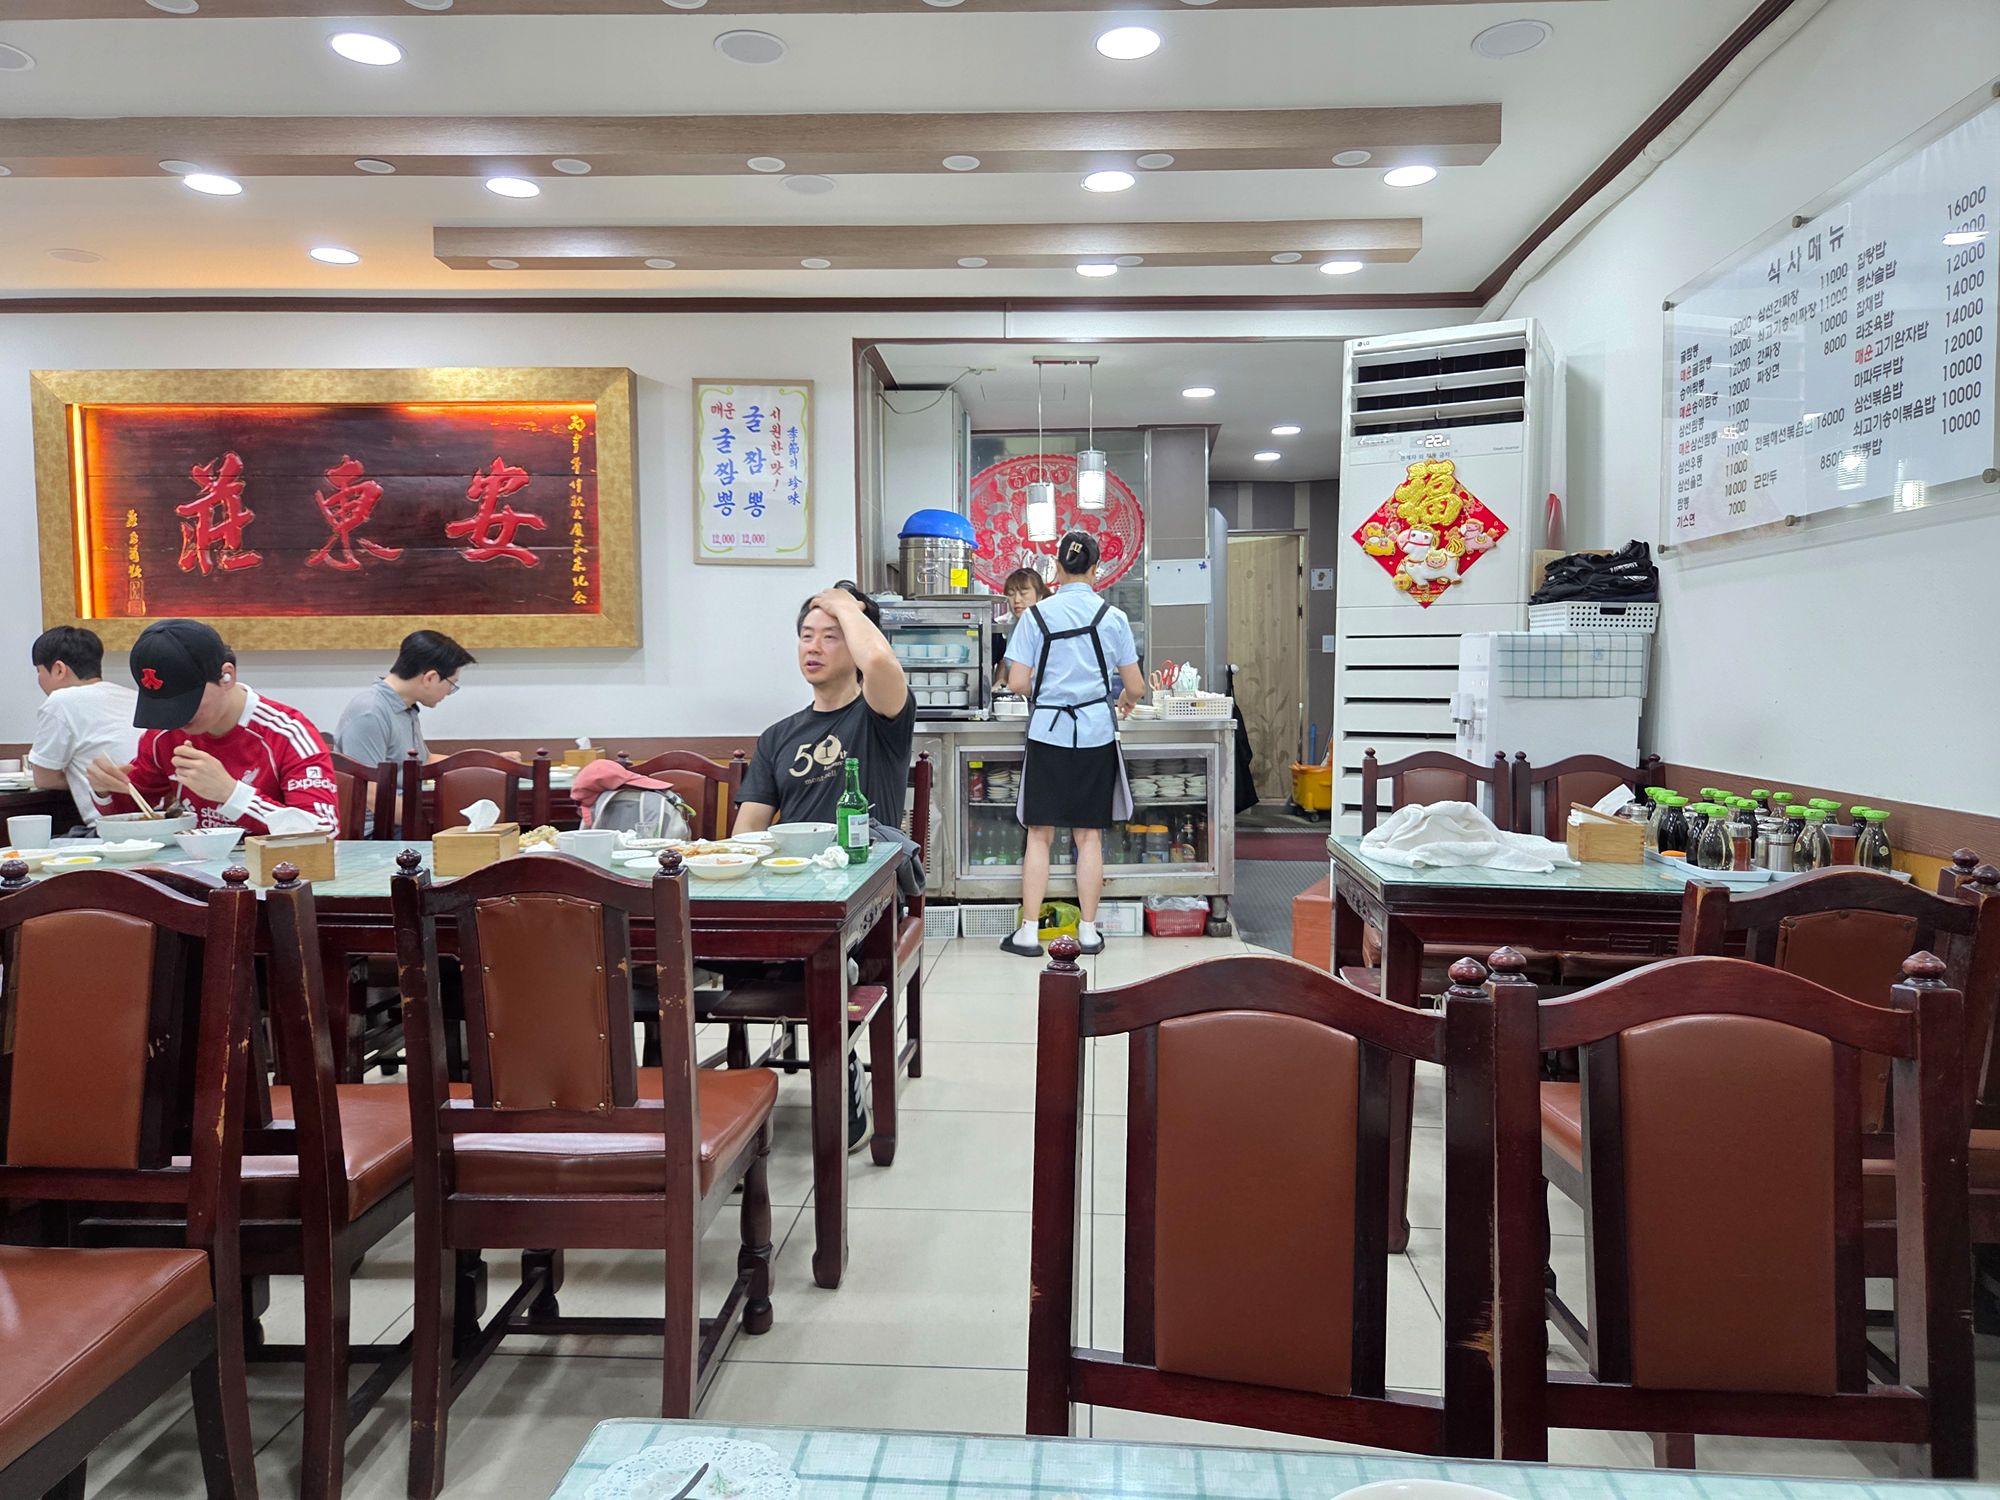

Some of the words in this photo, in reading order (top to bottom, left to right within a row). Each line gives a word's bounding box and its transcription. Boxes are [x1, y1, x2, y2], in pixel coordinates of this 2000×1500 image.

[1857, 240, 1887, 271] 잡탕밥
[1947, 185, 1986, 221] 16000
[1768, 225, 1844, 284] 식사메뉴
[1856, 289, 1884, 319] 잡채밥
[1947, 242, 1985, 275] 12000
[1857, 260, 1897, 294] 류산슬밥
[1757, 288, 1799, 323] 삼선간짜장
[1820, 262, 1848, 289] 11000
[1856, 310, 1894, 340] 라조육밥
[1946, 269, 1984, 301] 14000
[1729, 314, 1752, 338] 12000
[1757, 301, 1817, 343] 쇠고기송이짜장
[1820, 286, 1848, 313] 11000
[1945, 298, 1984, 328] 14000
[1729, 336, 1752, 358] 12000
[1757, 341, 1781, 365] 간짜장
[1820, 309, 1847, 335] 10000
[1729, 356, 1751, 378] 12000
[1756, 362, 1780, 384] 짜장면
[1823, 333, 1847, 356] 8000
[1854, 355, 1904, 388] 마파두부밥
[1944, 325, 1983, 355] 12000
[1728, 377, 1751, 398] 12000
[1854, 381, 1903, 414] 삼선볶음밥
[1943, 353, 1982, 382] 10000
[710, 401, 735, 421] 매운
[1728, 398, 1750, 417] 11000
[1816, 407, 1845, 430] 16000
[1853, 395, 1936, 436] 쇠고기송이볶음밥
[1942, 381, 1981, 409] 10000
[1941, 408, 1981, 435] 10000
[1726, 439, 1748, 457] 11000
[1726, 459, 1748, 478] 11000
[1753, 469, 1778, 490] 군만두
[1820, 450, 1843, 470] 8500
[1728, 500, 1746, 516] 7000
[712, 533, 735, 545] 12,000
[741, 533, 765, 545] 12,000
